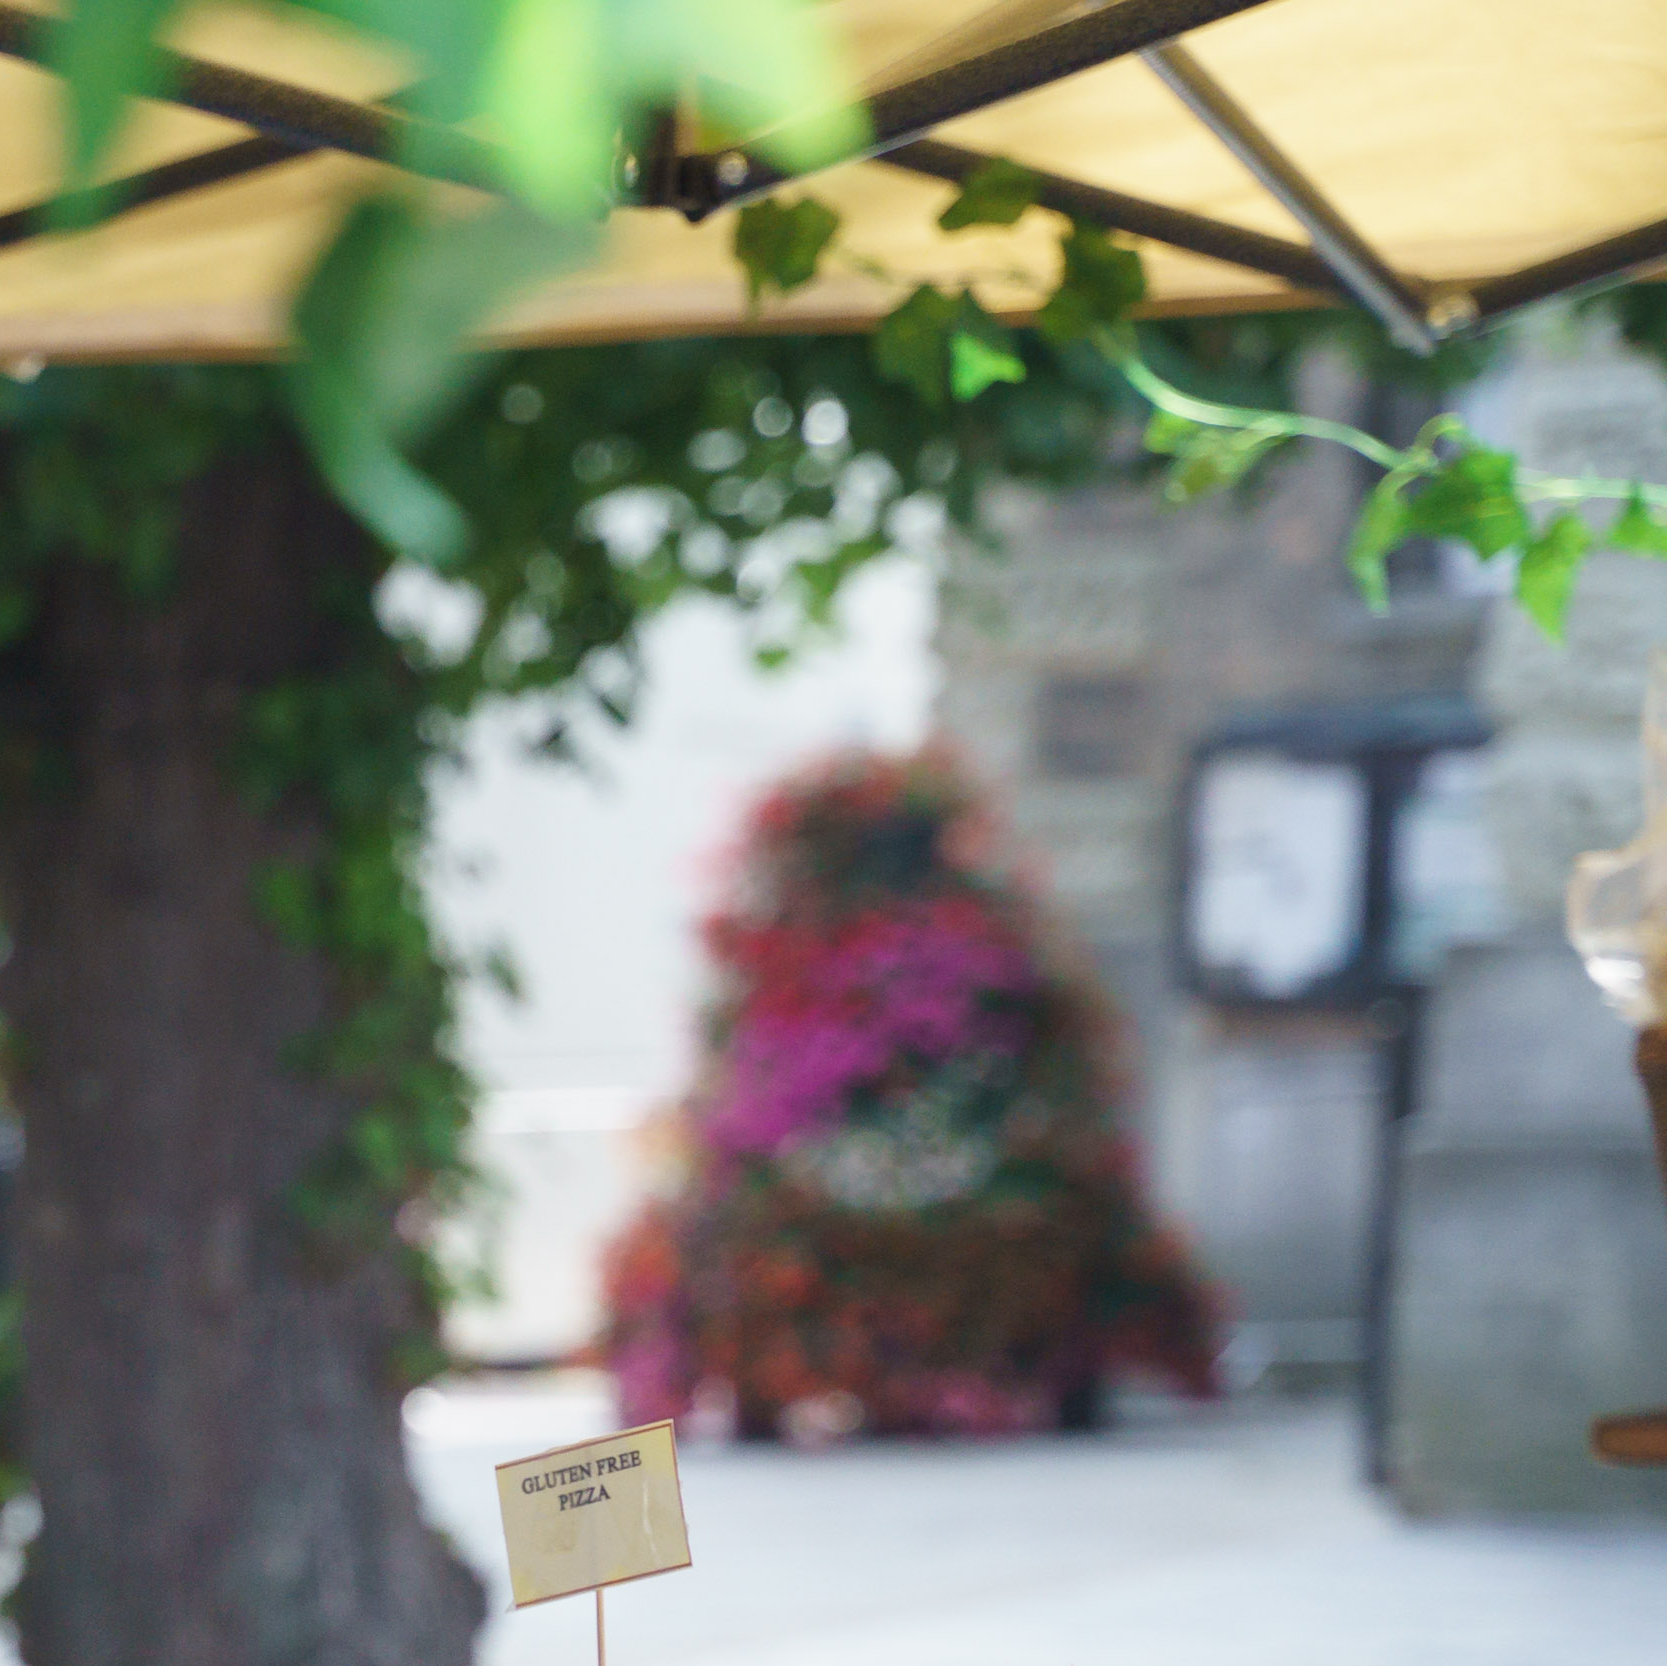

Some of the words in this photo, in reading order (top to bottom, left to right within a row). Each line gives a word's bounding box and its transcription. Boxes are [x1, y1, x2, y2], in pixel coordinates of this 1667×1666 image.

[521, 1462, 593, 1495] GLUTEN
[595, 1450, 643, 1477] FREE
[558, 1483, 611, 1512] PIZZA
